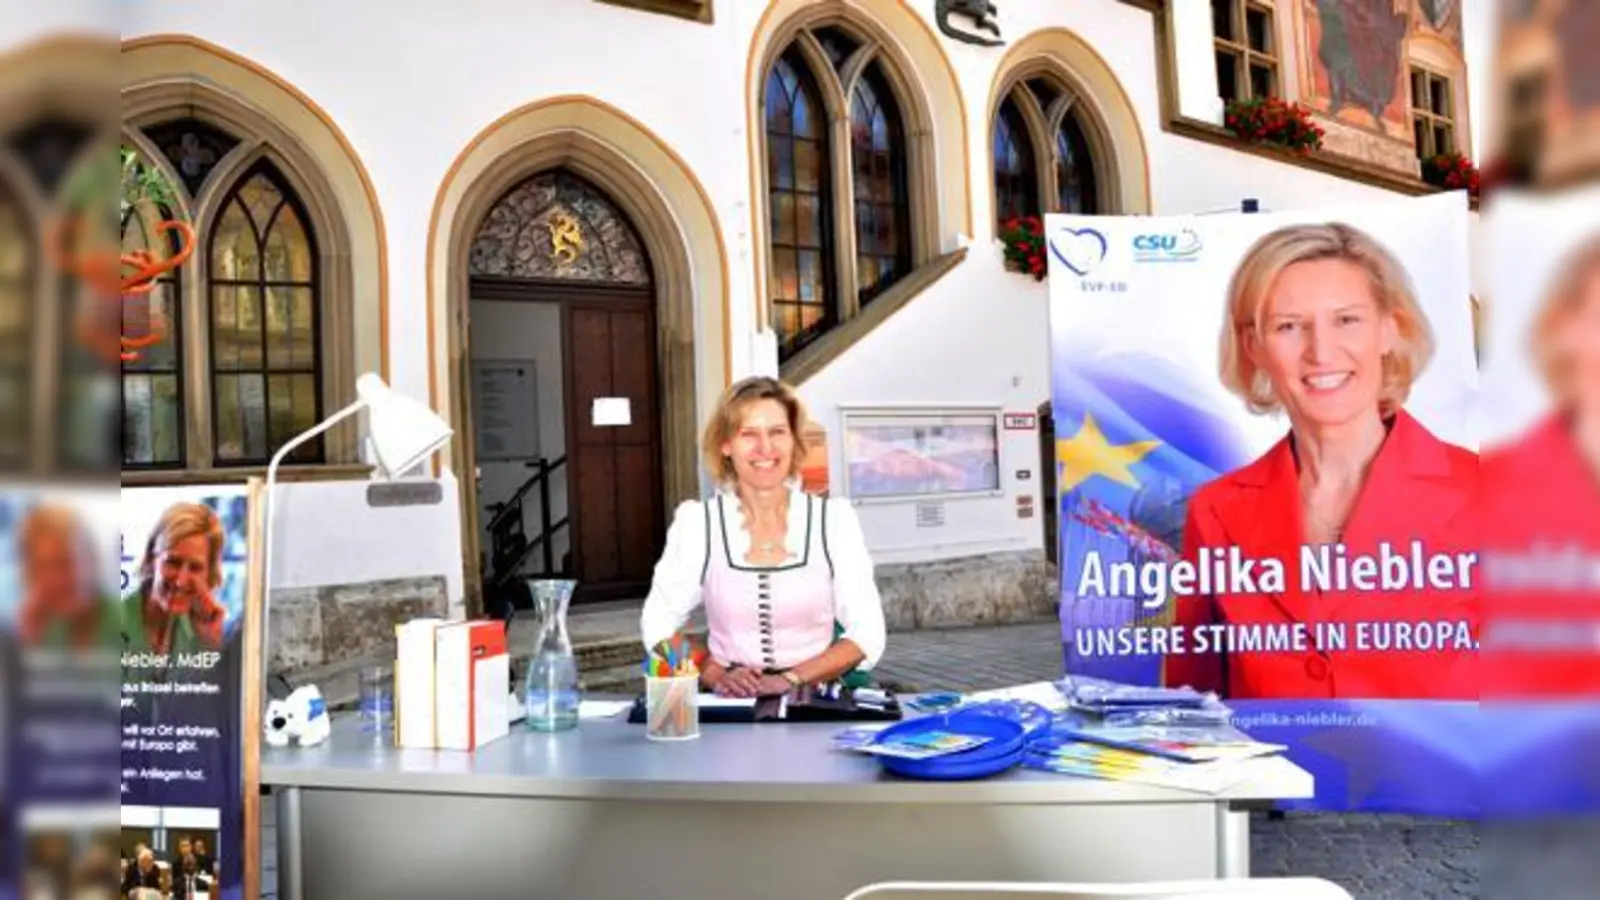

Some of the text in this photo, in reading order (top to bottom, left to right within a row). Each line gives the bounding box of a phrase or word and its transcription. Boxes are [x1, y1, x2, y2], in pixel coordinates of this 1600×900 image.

[1133, 234, 1177, 250] CSU
[1077, 547, 1285, 609] Angelika
[1301, 541, 1478, 591] Niebler
[1076, 624, 1185, 656] UNSERE
[1191, 622, 1307, 653] STIMME
[1315, 623, 1348, 650] IN
[1356, 620, 1480, 650] EUROPA.
[176, 651, 221, 669] MdEP
[1229, 711, 1377, 729] ngelika-niebler.de
[157, 725, 174, 736] Ort
[140, 739, 175, 752] Europa
